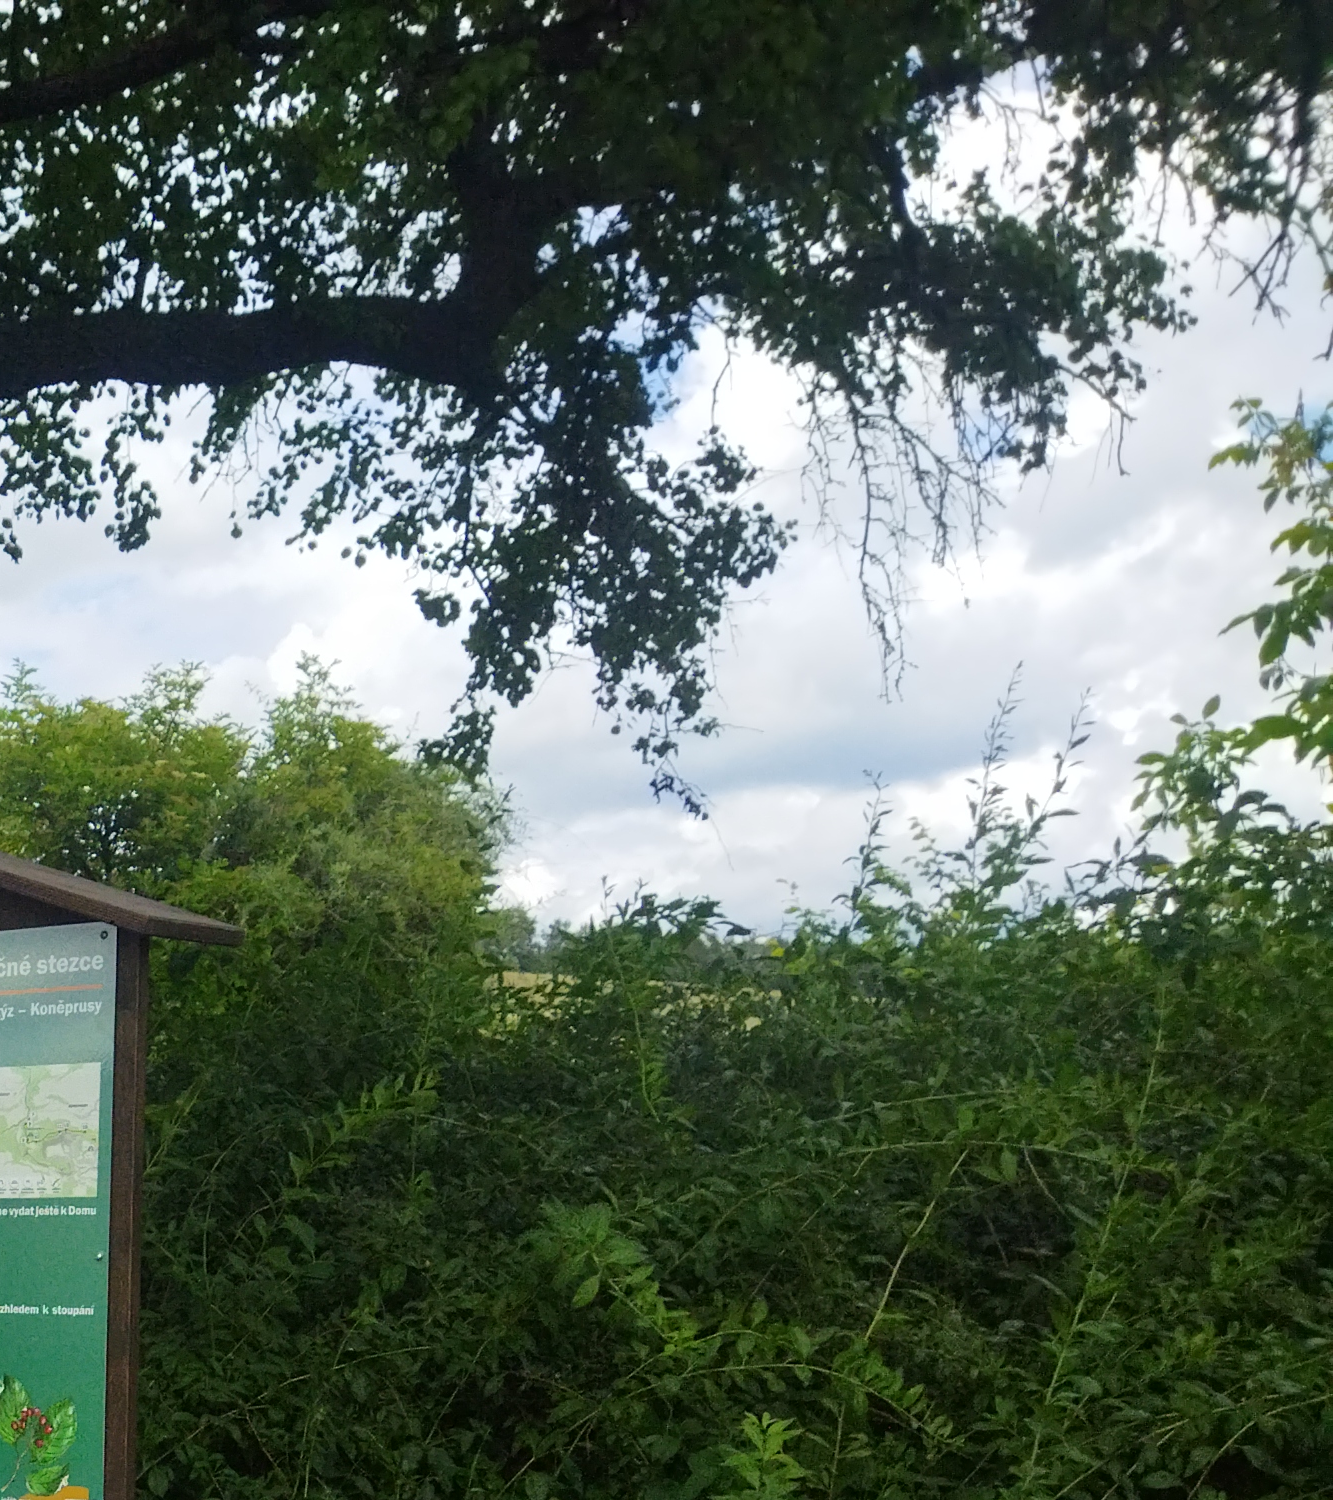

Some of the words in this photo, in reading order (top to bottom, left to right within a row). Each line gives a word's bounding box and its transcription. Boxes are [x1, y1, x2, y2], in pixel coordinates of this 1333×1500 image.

[37, 951, 104, 974] stezce
[30, 997, 102, 1018] Koněprusy
[9, 1206, 34, 1217] vydat
[68, 1205, 97, 1215] Domu
